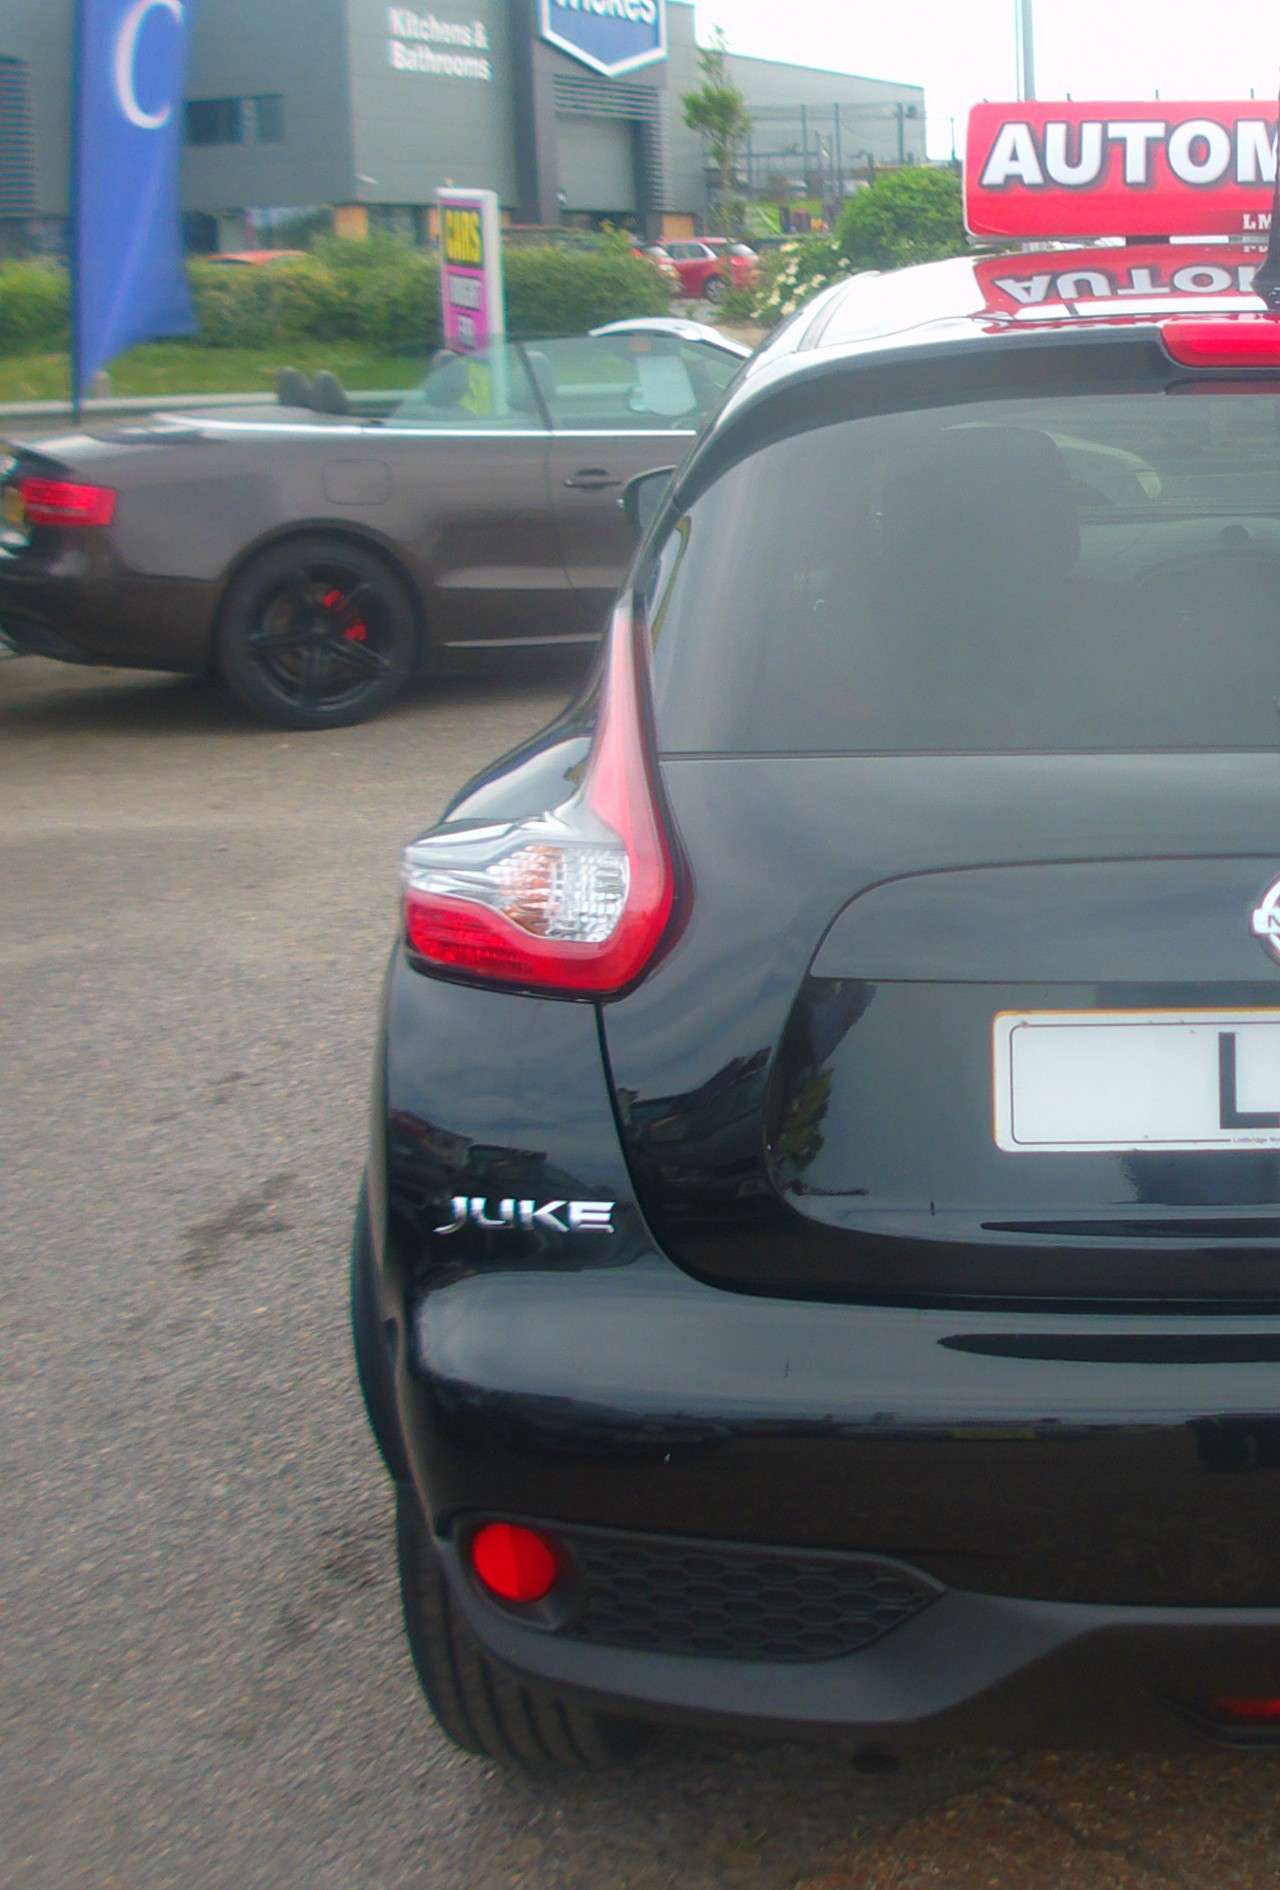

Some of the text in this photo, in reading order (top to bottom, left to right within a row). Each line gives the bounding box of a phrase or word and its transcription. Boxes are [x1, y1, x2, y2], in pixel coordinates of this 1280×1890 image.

[389, 6, 489, 49] Kitchens &
[389, 38, 492, 80] Bathrooms
[432, 1195, 616, 1235] JUKE
